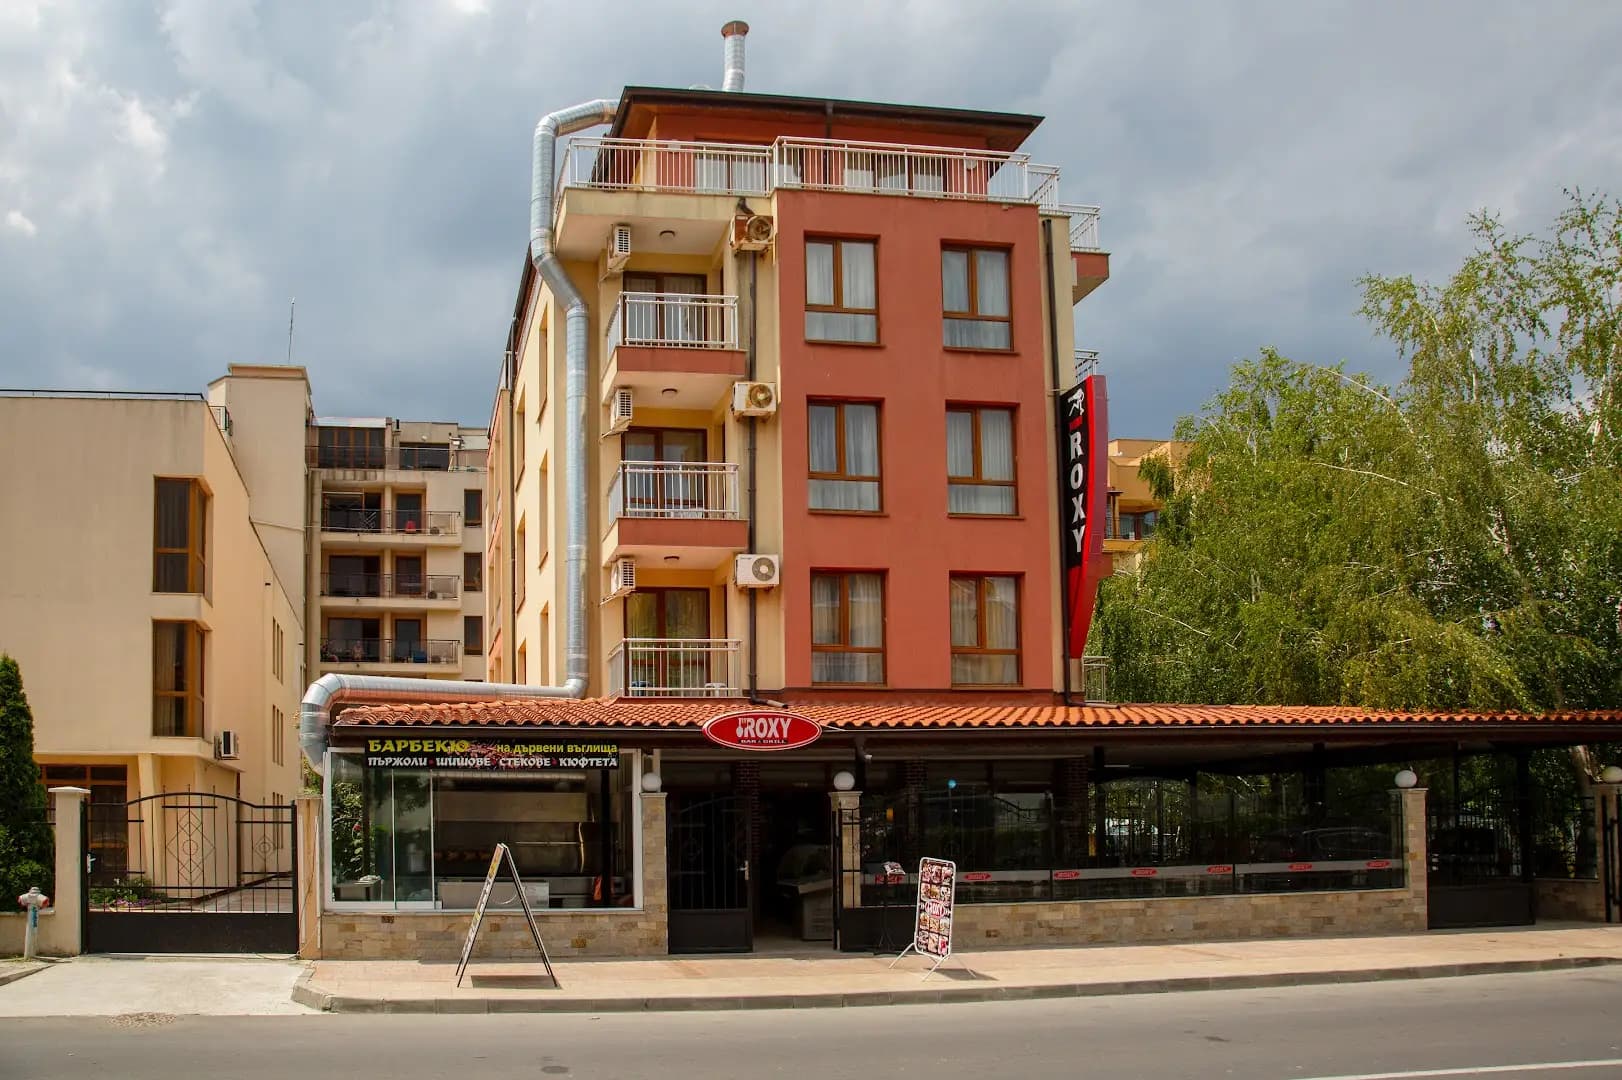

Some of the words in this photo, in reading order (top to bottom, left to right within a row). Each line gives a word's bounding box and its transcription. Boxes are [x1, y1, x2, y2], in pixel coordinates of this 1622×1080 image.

[1069, 431, 1086, 553] ROXY
[743, 717, 792, 738] ROXY
[368, 739, 470, 753] БАРБЕКЮ
[496, 745, 511, 753] на
[513, 744, 564, 755] дървени
[567, 744, 618, 755] въглища
[367, 757, 428, 767] ПЪРЖОЛИ
[499, 757, 551, 767] СТЕКОВЕ
[559, 757, 618, 768] КЮФТЕТА
